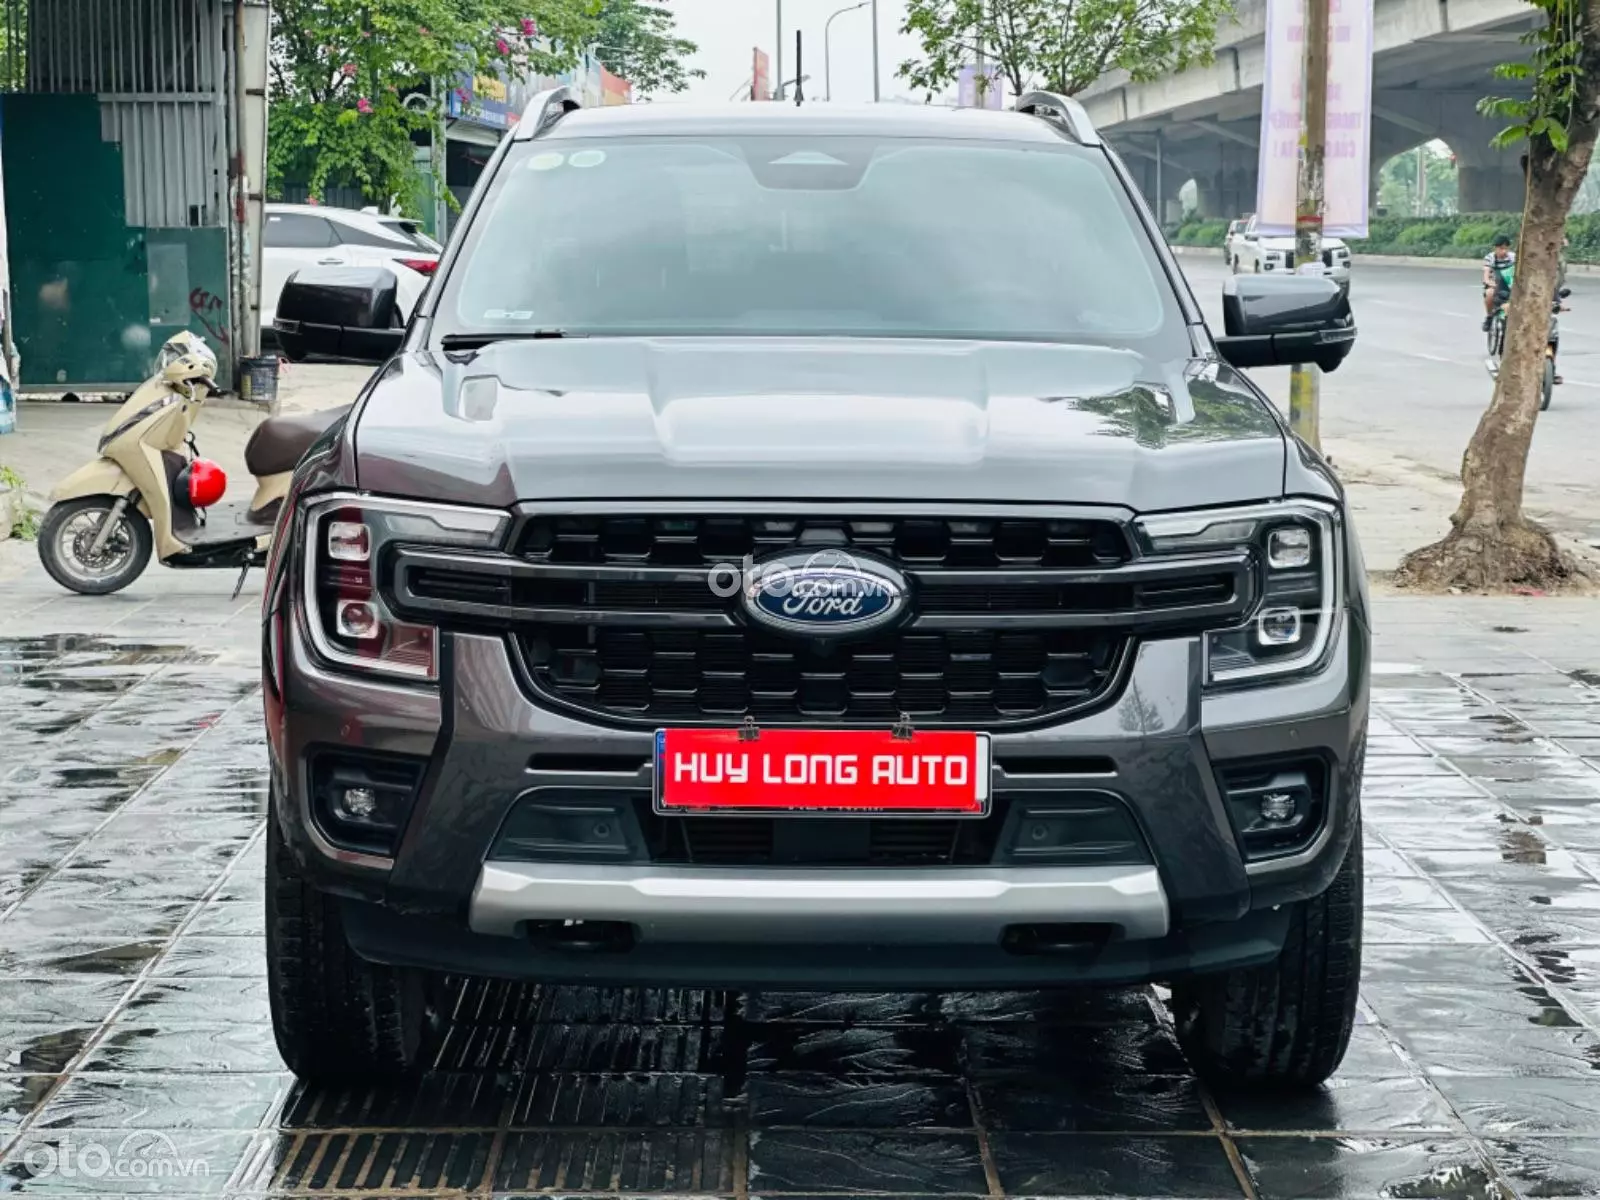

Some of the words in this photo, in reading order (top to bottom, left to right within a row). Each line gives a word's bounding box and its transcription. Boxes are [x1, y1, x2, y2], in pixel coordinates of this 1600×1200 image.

[782, 580, 864, 615] Ford
[673, 752, 749, 784] HUY
[763, 754, 858, 785] LONG
[872, 755, 968, 786] AUTO
